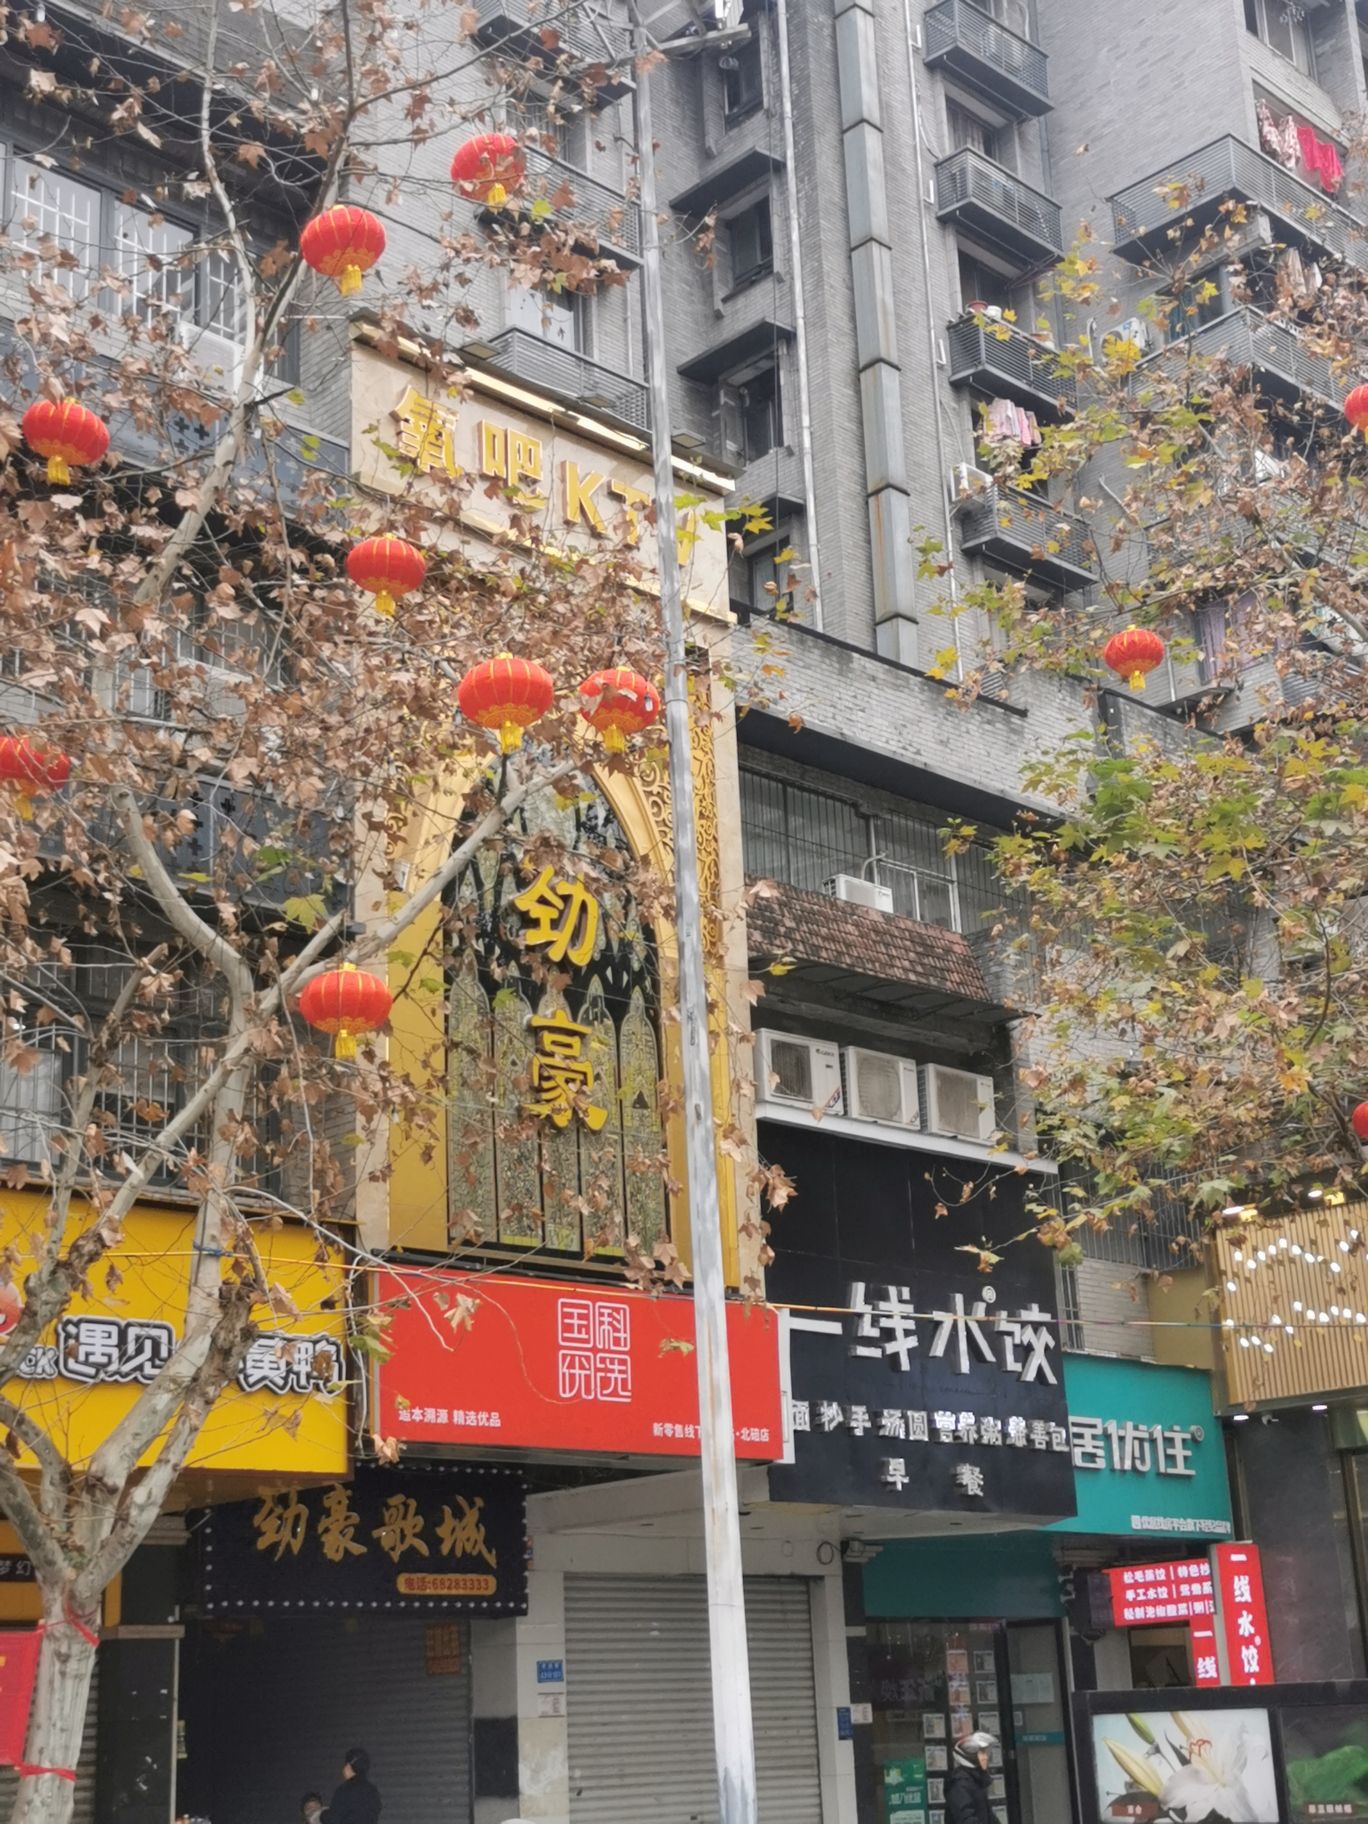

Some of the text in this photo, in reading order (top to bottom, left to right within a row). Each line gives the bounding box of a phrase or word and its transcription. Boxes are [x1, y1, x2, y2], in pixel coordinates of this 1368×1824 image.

[513, 863, 608, 1131] 劲豪
[557, 1297, 631, 1351] 国科
[787, 1281, 1058, 1386] 一线水饺
[558, 1350, 632, 1403] 优选
[453, 1409, 502, 1427] 精选优品
[253, 1482, 497, 1569] 劲豪歌城
[1125, 1585, 1169, 1602] 手工水饺
[1230, 1553, 1262, 1686] 一线水饺
[1192, 1630, 1219, 1679] 一线
